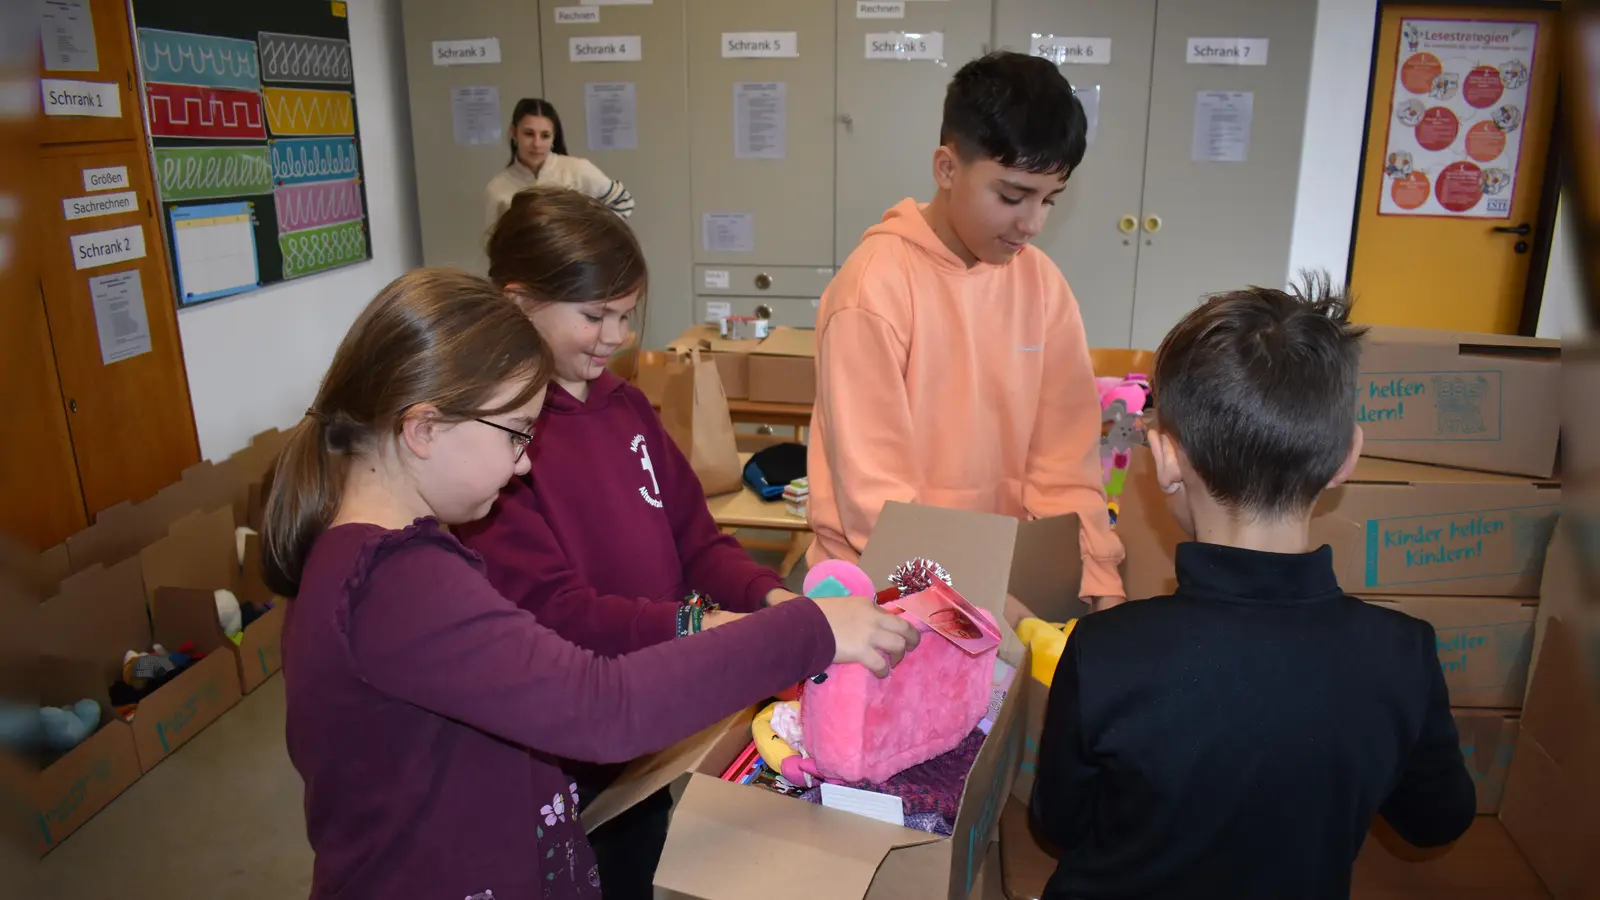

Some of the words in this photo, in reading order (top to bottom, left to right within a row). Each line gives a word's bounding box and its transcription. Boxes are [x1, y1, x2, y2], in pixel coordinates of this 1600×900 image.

[860, 4, 900, 13] Rechnen
[558, 11, 595, 21] Rechnen
[728, 37, 771, 50] Schrank
[774, 39, 780, 50] 5
[1425, 30, 1509, 45] Lesestrategien
[438, 46, 477, 59] Schrank
[479, 46, 486, 57] 3
[576, 44, 616, 56] Schrank
[618, 44, 626, 54] 4
[919, 41, 926, 52] 5
[1038, 44, 1083, 56] Schank
[1086, 45, 1093, 56] 6
[1194, 46, 1240, 58] Schrank
[1242, 47, 1250, 58] 7
[49, 90, 95, 107] Schrank
[96, 94, 103, 108] 1
[90, 172, 123, 186] Größen
[73, 198, 130, 215] Sachrechnen
[79, 238, 123, 260] Schrank
[123, 238, 131, 252] 2
[1369, 378, 1425, 399] helfen
[1356, 401, 1404, 422] dern!
[1384, 525, 1444, 548] Kinder
[1450, 516, 1504, 540] helfen
[1405, 539, 1483, 567] Kindern!
